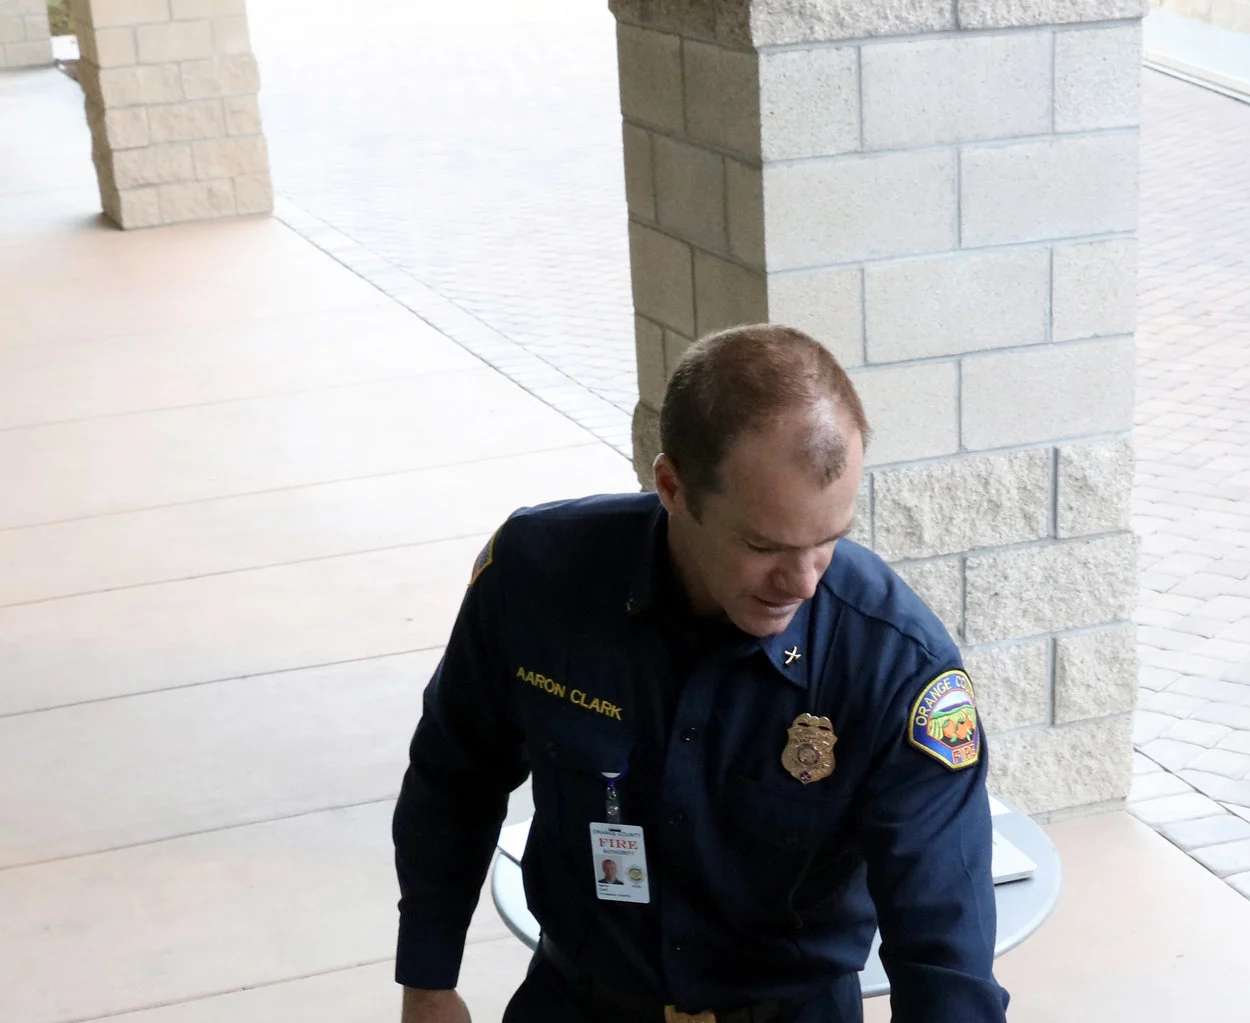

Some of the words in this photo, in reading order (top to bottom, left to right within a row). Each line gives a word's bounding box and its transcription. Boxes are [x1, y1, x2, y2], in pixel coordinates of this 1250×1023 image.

[516, 666, 566, 699] AARON
[569, 688, 623, 721] CLARK
[915, 677, 953, 726] ORANGE
[599, 838, 638, 850] FIRE
